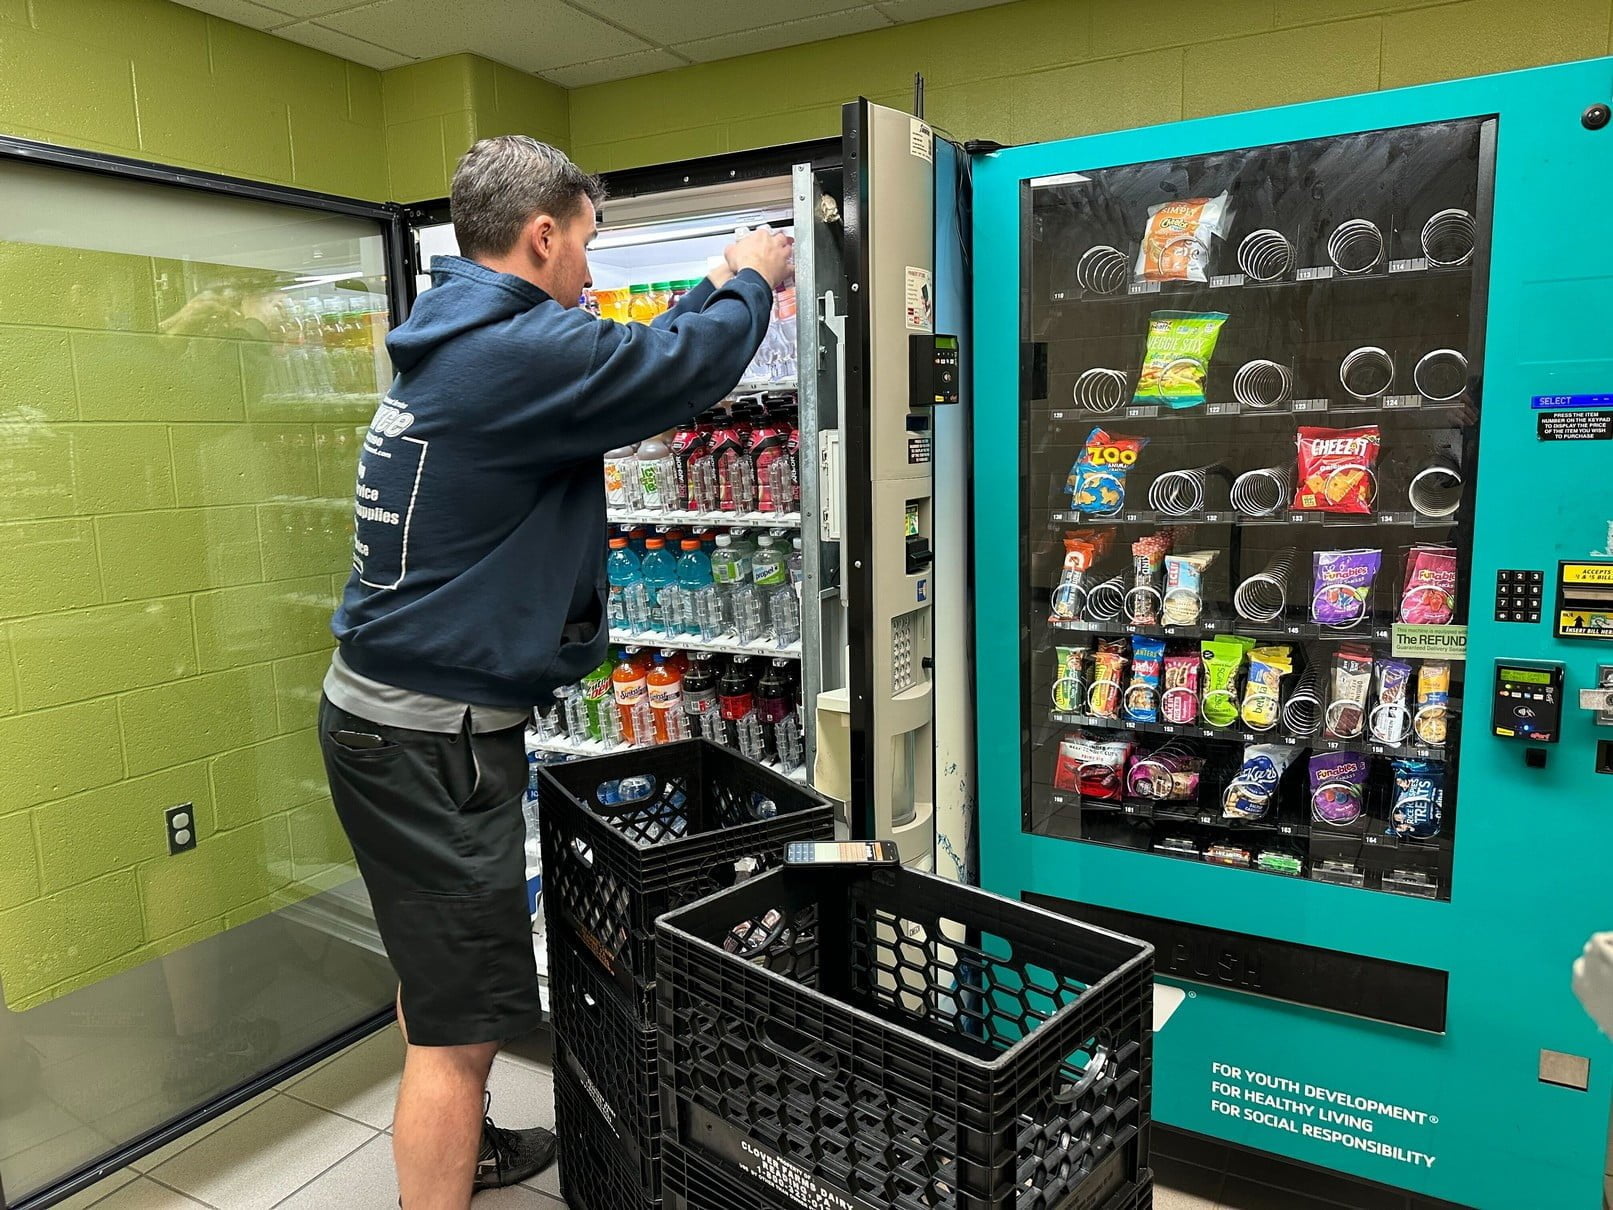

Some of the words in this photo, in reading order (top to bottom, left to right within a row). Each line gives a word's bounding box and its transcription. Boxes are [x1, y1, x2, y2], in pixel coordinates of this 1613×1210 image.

[1161, 206, 1194, 216] SIMPLY
[1539, 396, 1571, 405] SELECT
[1088, 446, 1137, 465] ZOO
[356, 482, 379, 501] vice
[356, 502, 400, 525] upplies
[756, 567, 774, 580] propel
[1323, 567, 1368, 580] Funables
[1397, 634, 1417, 645] The
[1420, 635, 1467, 646] REFUND
[1134, 649, 1158, 657] ANTERS
[1316, 763, 1357, 780] Funables
[1170, 944, 1262, 988] PUSH
[1212, 1062, 1241, 1080] FOR
[1245, 1070, 1300, 1094] YOUTH
[1211, 1081, 1241, 1099] FOR
[1244, 1088, 1315, 1116] HEALTHY
[1319, 1108, 1373, 1132] LIVING
[1211, 1100, 1240, 1118] FOR
[1243, 1109, 1298, 1133] SOCIAL
[1302, 1123, 1436, 1168] RESPONSIBILITY
[741, 1141, 779, 1170] CLOVER
[782, 1165, 816, 1192] FARMS
[820, 1187, 853, 1210] DAIRY
